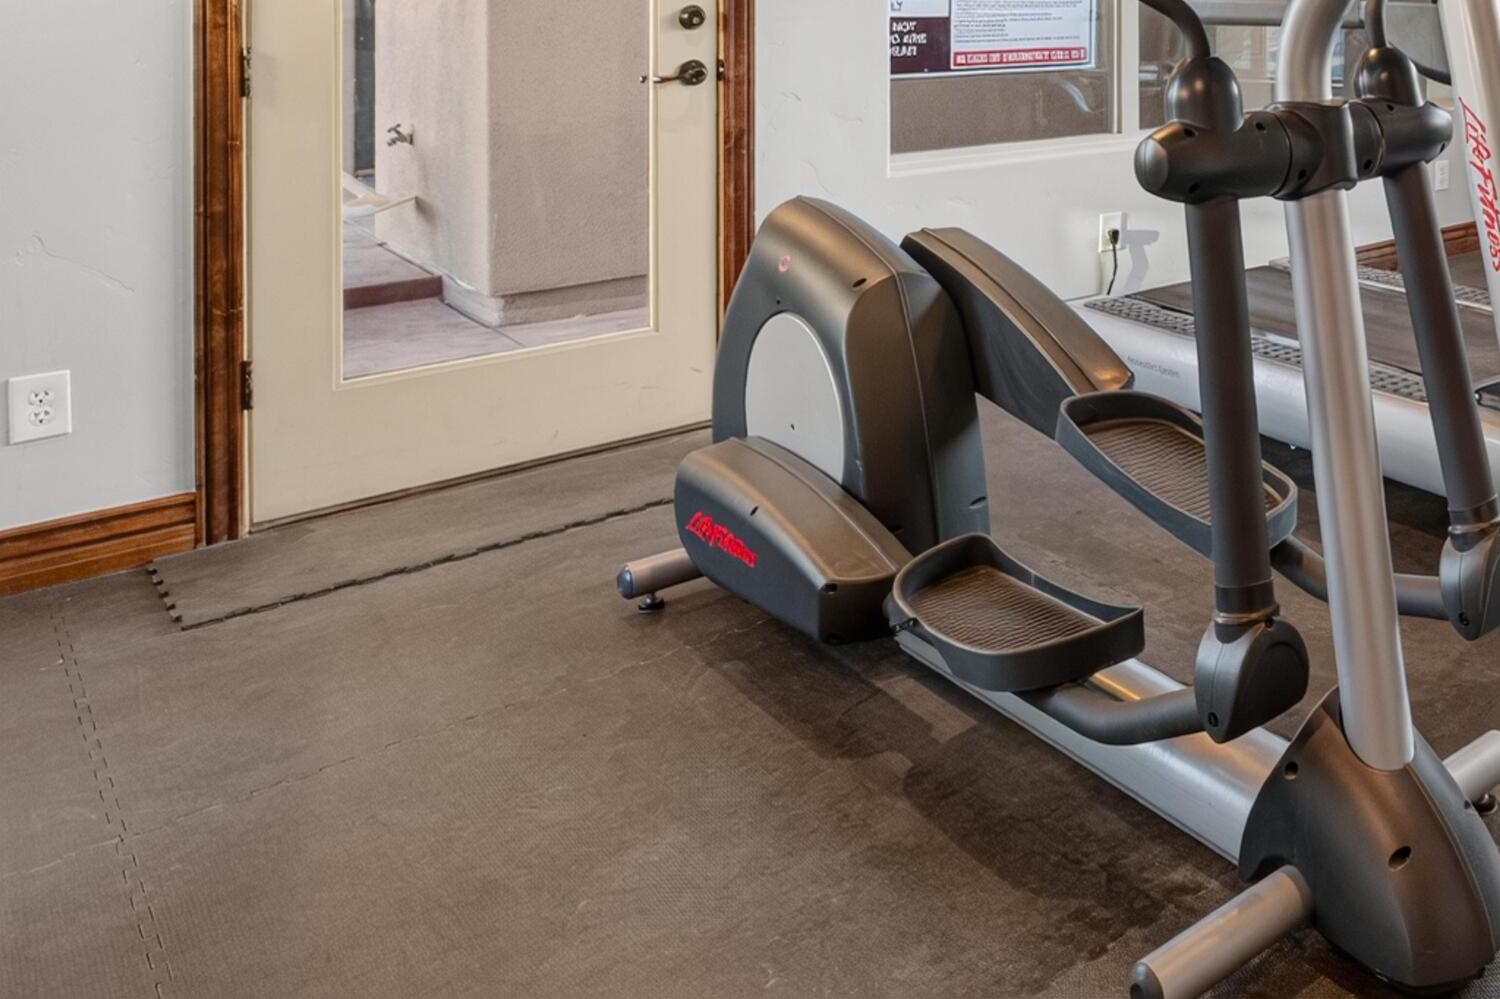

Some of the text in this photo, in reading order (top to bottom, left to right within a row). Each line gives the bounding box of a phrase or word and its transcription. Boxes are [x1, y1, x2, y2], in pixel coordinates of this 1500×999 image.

[892, 21, 917, 32] NOT
[1458, 96, 1493, 164] Life
[685, 511, 758, 569] Life Fitness
